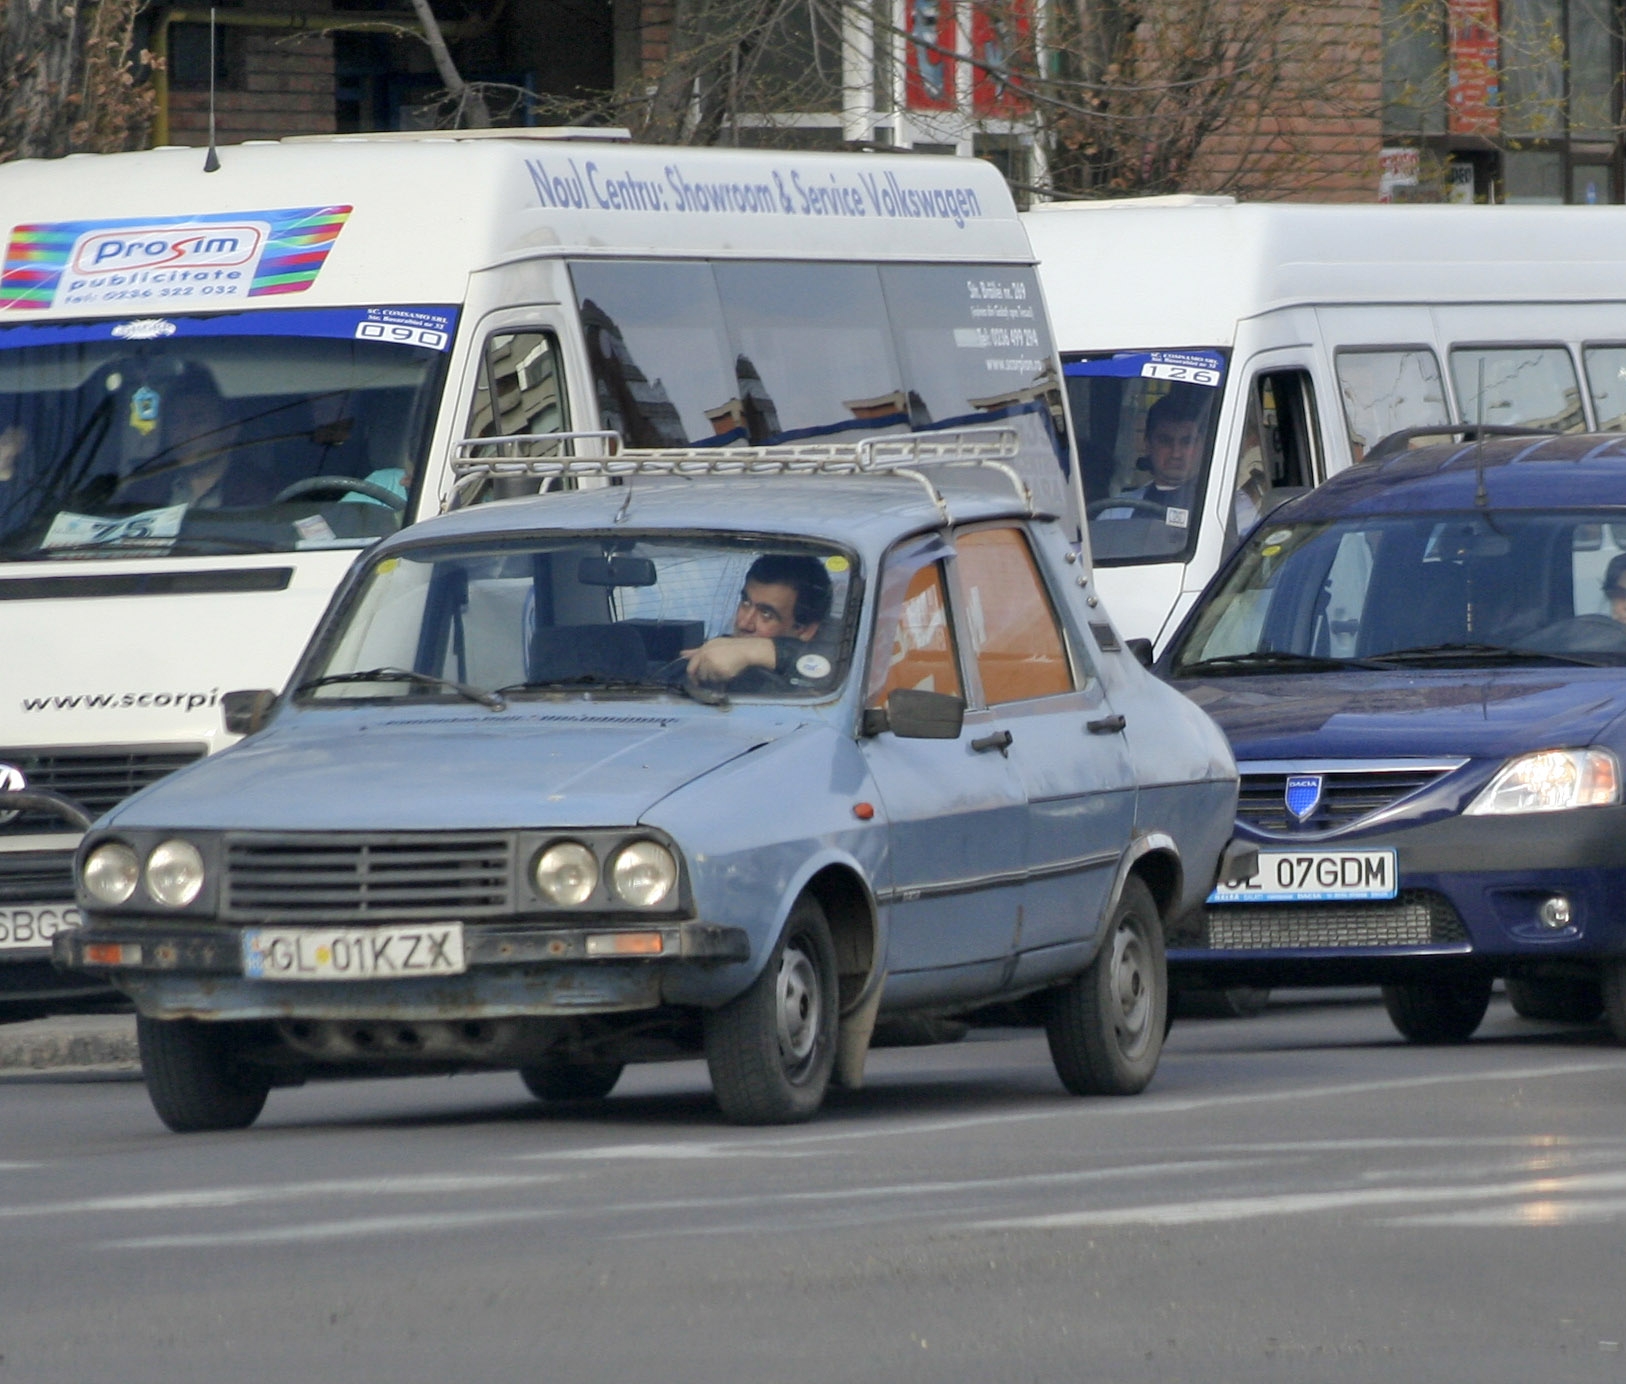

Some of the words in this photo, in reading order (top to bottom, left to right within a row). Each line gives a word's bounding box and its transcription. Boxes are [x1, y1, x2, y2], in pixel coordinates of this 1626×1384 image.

[525, 158, 590, 208] Noul
[585, 161, 669, 211] Centru:
[664, 164, 777, 213] Showroom
[772, 170, 795, 215] &
[790, 170, 866, 216] Service
[857, 171, 982, 229] Volkswagen
[68, 269, 242, 292] publicitate
[160, 286, 193, 296] 322
[201, 285, 238, 295] 032
[361, 325, 442, 346] 090
[1149, 365, 1212, 383] 126
[22, 688, 220, 712] www.scorpi
[1277, 857, 1386, 888] 07GDM
